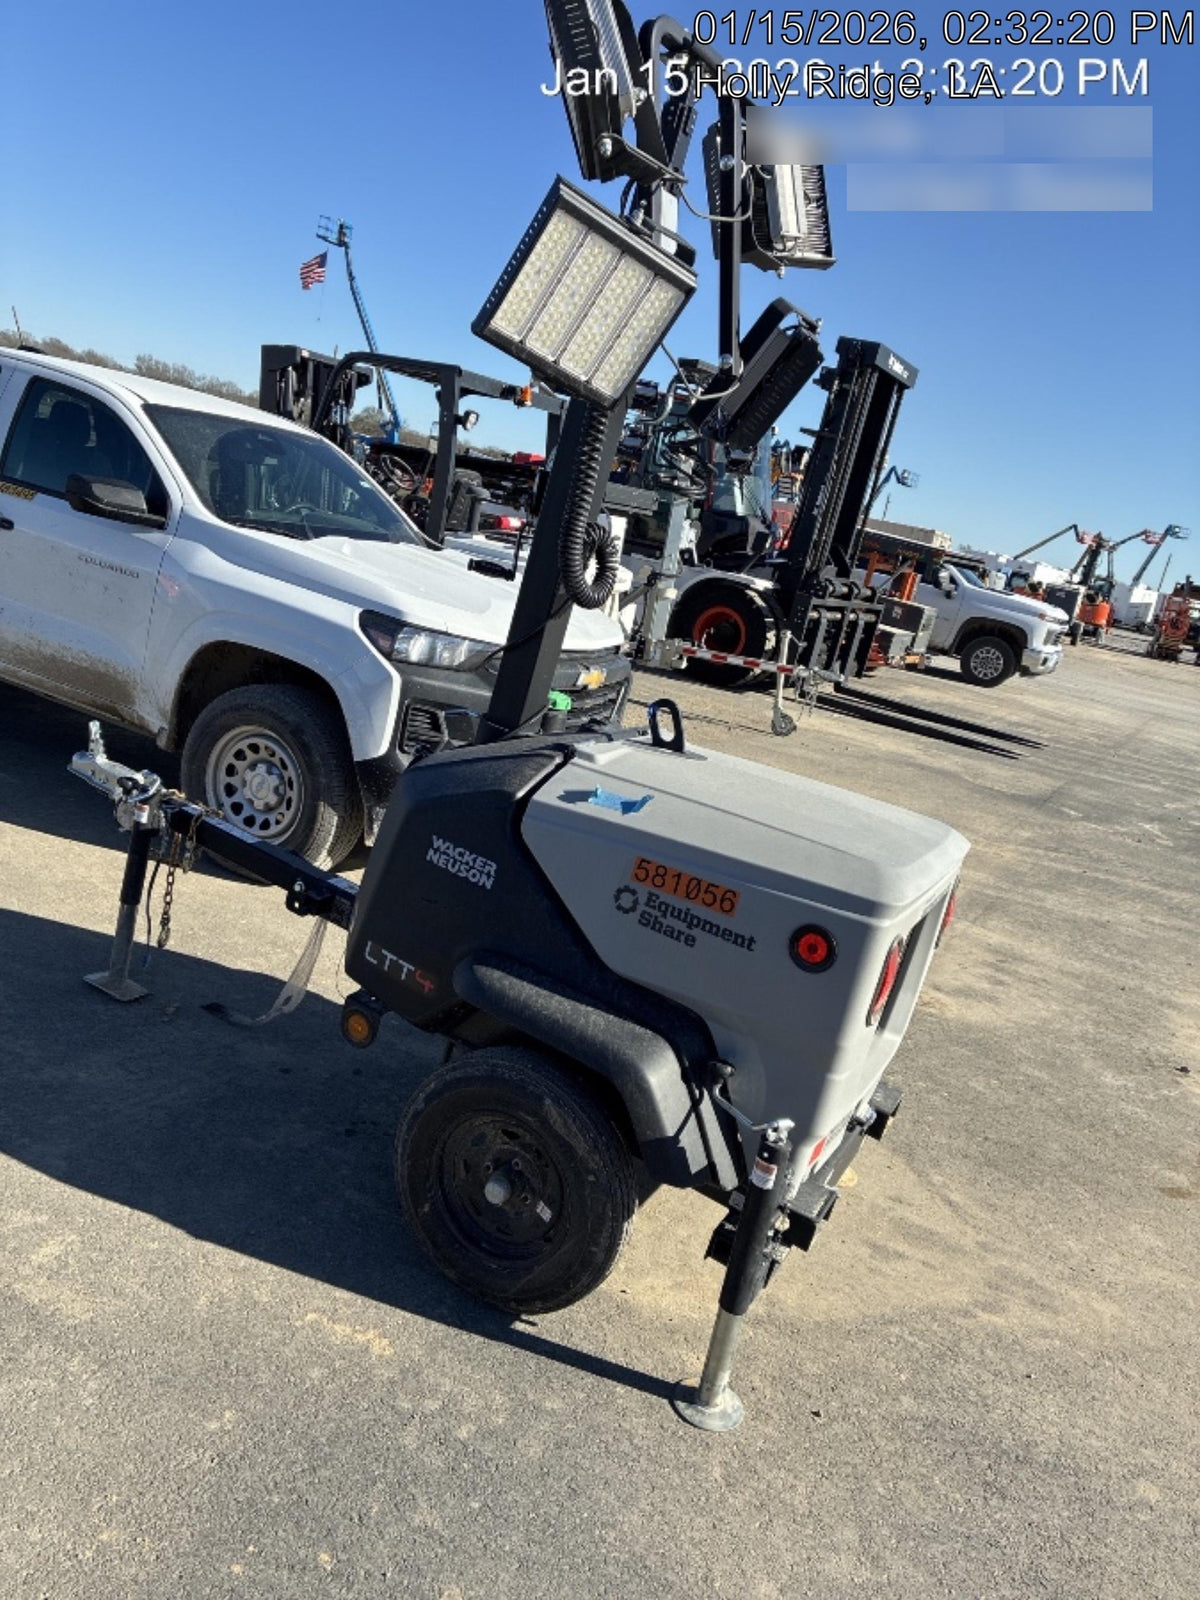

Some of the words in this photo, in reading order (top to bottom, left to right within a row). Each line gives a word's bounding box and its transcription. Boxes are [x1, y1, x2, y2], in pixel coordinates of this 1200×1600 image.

[425, 847, 496, 891] NEUSON
[432, 834, 498, 878] WACKER
[633, 857, 738, 914] 581056
[637, 909, 698, 949] Share
[643, 890, 757, 953] Equipment
[364, 940, 435, 994] LTT4
